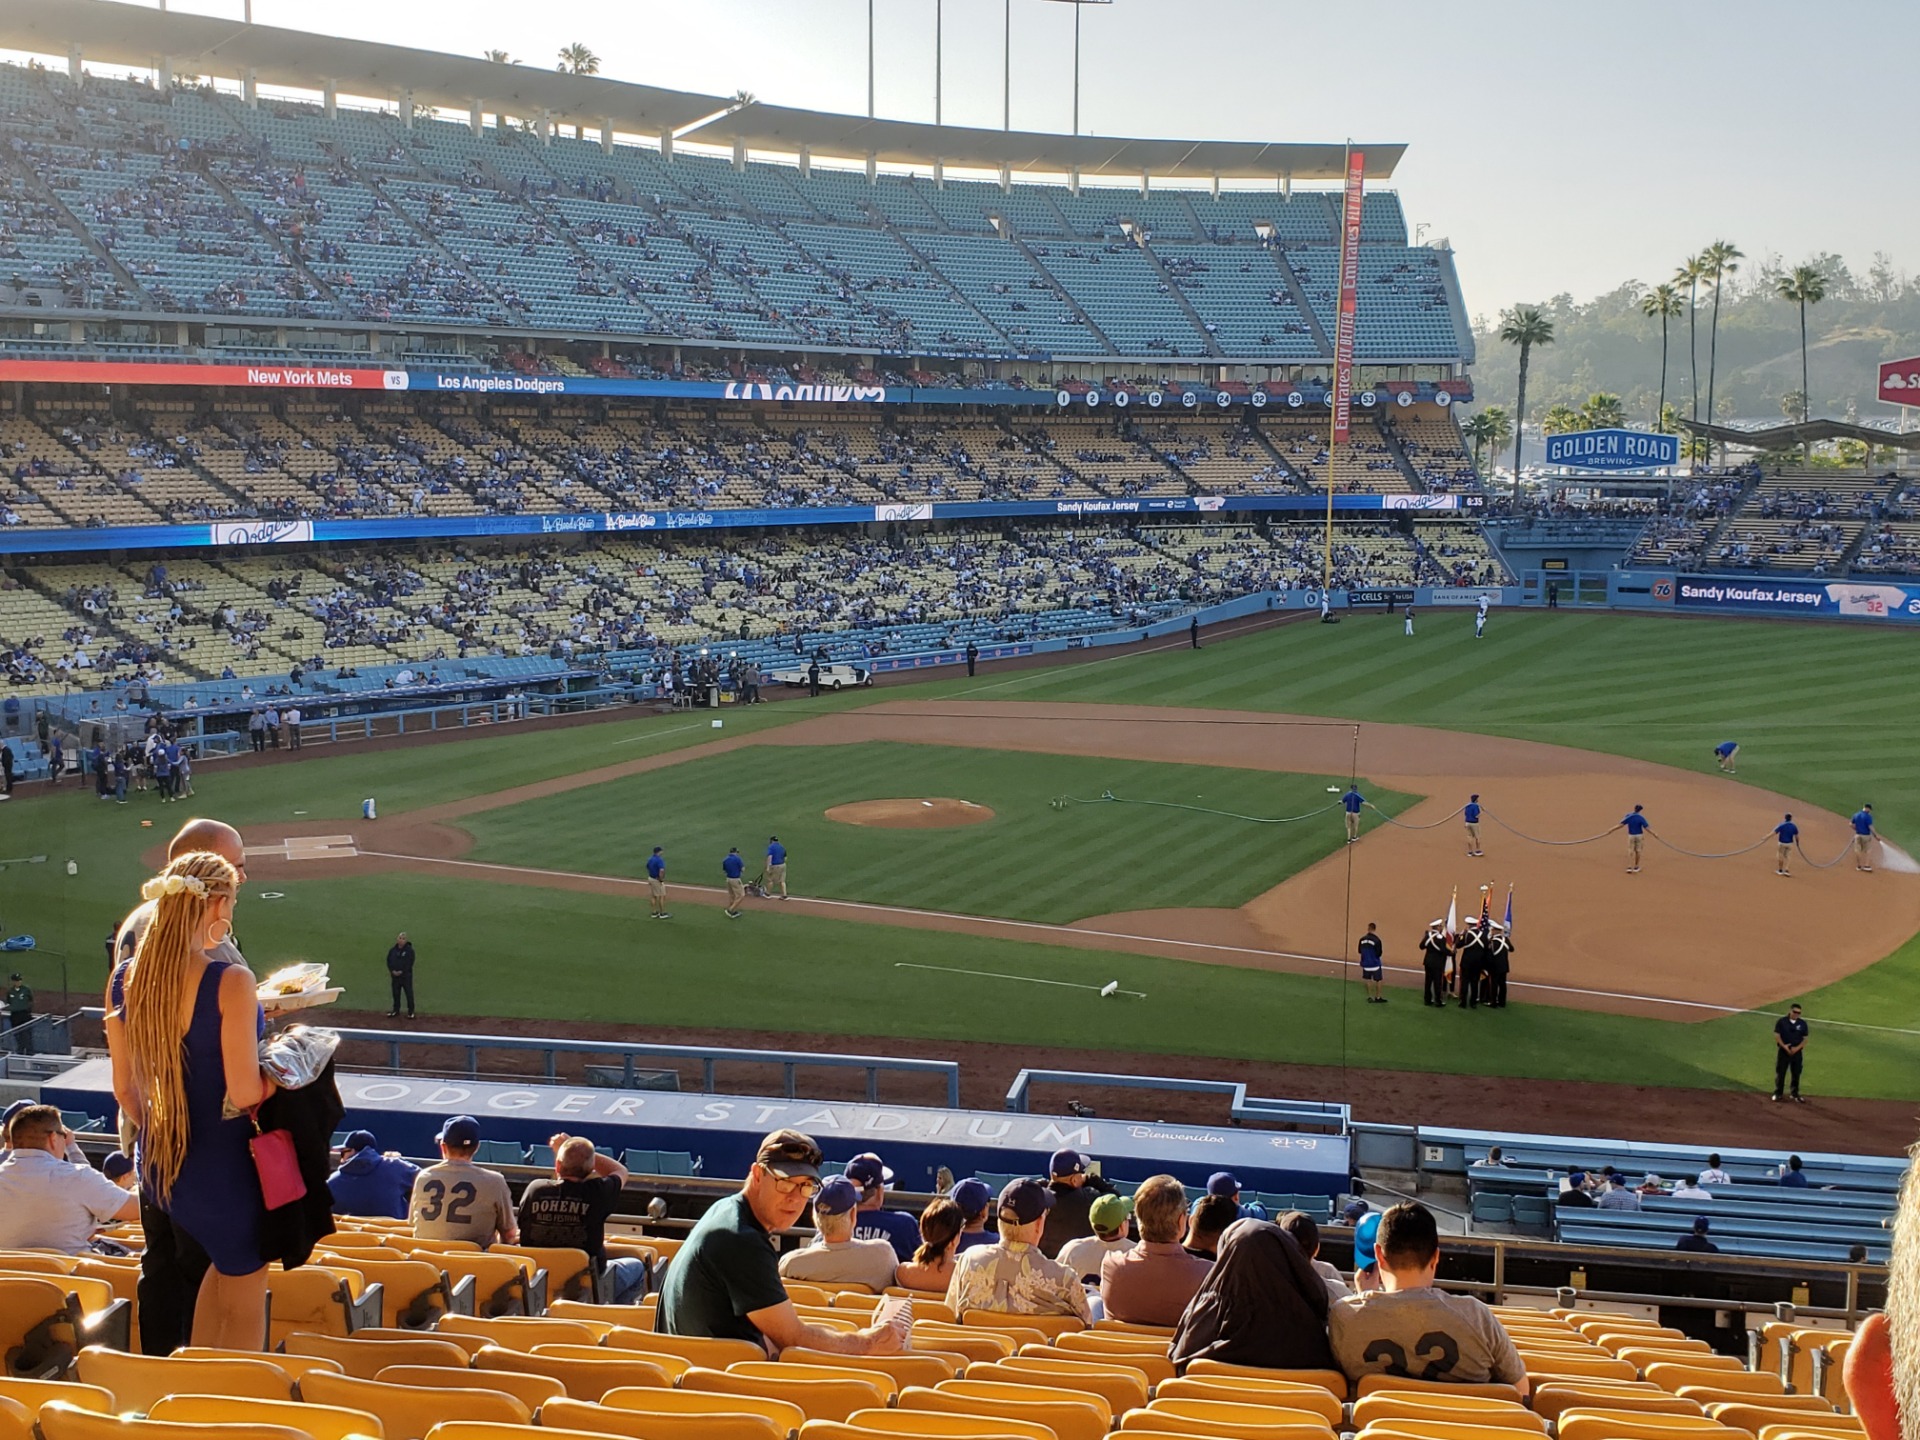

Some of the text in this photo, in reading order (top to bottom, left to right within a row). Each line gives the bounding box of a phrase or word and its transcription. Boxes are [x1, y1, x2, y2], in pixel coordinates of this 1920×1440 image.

[1342, 223, 1359, 290] Emirates
[1335, 311, 1353, 430] Emirates FLY BETTER
[248, 369, 353, 386] New York Mets
[390, 375, 401, 385] VS
[438, 375, 565, 394] Los Angeles Dodgers
[1150, 394, 1159, 403] 19
[1183, 394, 1194, 403] 20
[1218, 394, 1229, 403] 24
[1254, 394, 1265, 404] 32
[1289, 394, 1300, 404] 39
[1362, 394, 1374, 404] 53
[1551, 436, 1671, 461] GOLDEN ROAD
[1587, 457, 1633, 466] BREWING
[1057, 501, 1082, 513] Sandy
[1083, 501, 1111, 511] Koufax
[1112, 501, 1139, 513] Jersey
[1361, 592, 1382, 601] CELLS
[1655, 584, 1671, 596] 76
[1681, 585, 1822, 606] Sandy Koufax Jersey
[1867, 601, 1883, 612] 32
[334, 1082, 1092, 1146] ODGER STADIUM
[1127, 1125, 1225, 1144] Bienvenidos
[1268, 1136, 1318, 1150] 환영
[420, 1179, 478, 1224] 32
[531, 1200, 590, 1216] DOHENY
[855, 1226, 891, 1241] SHAW
